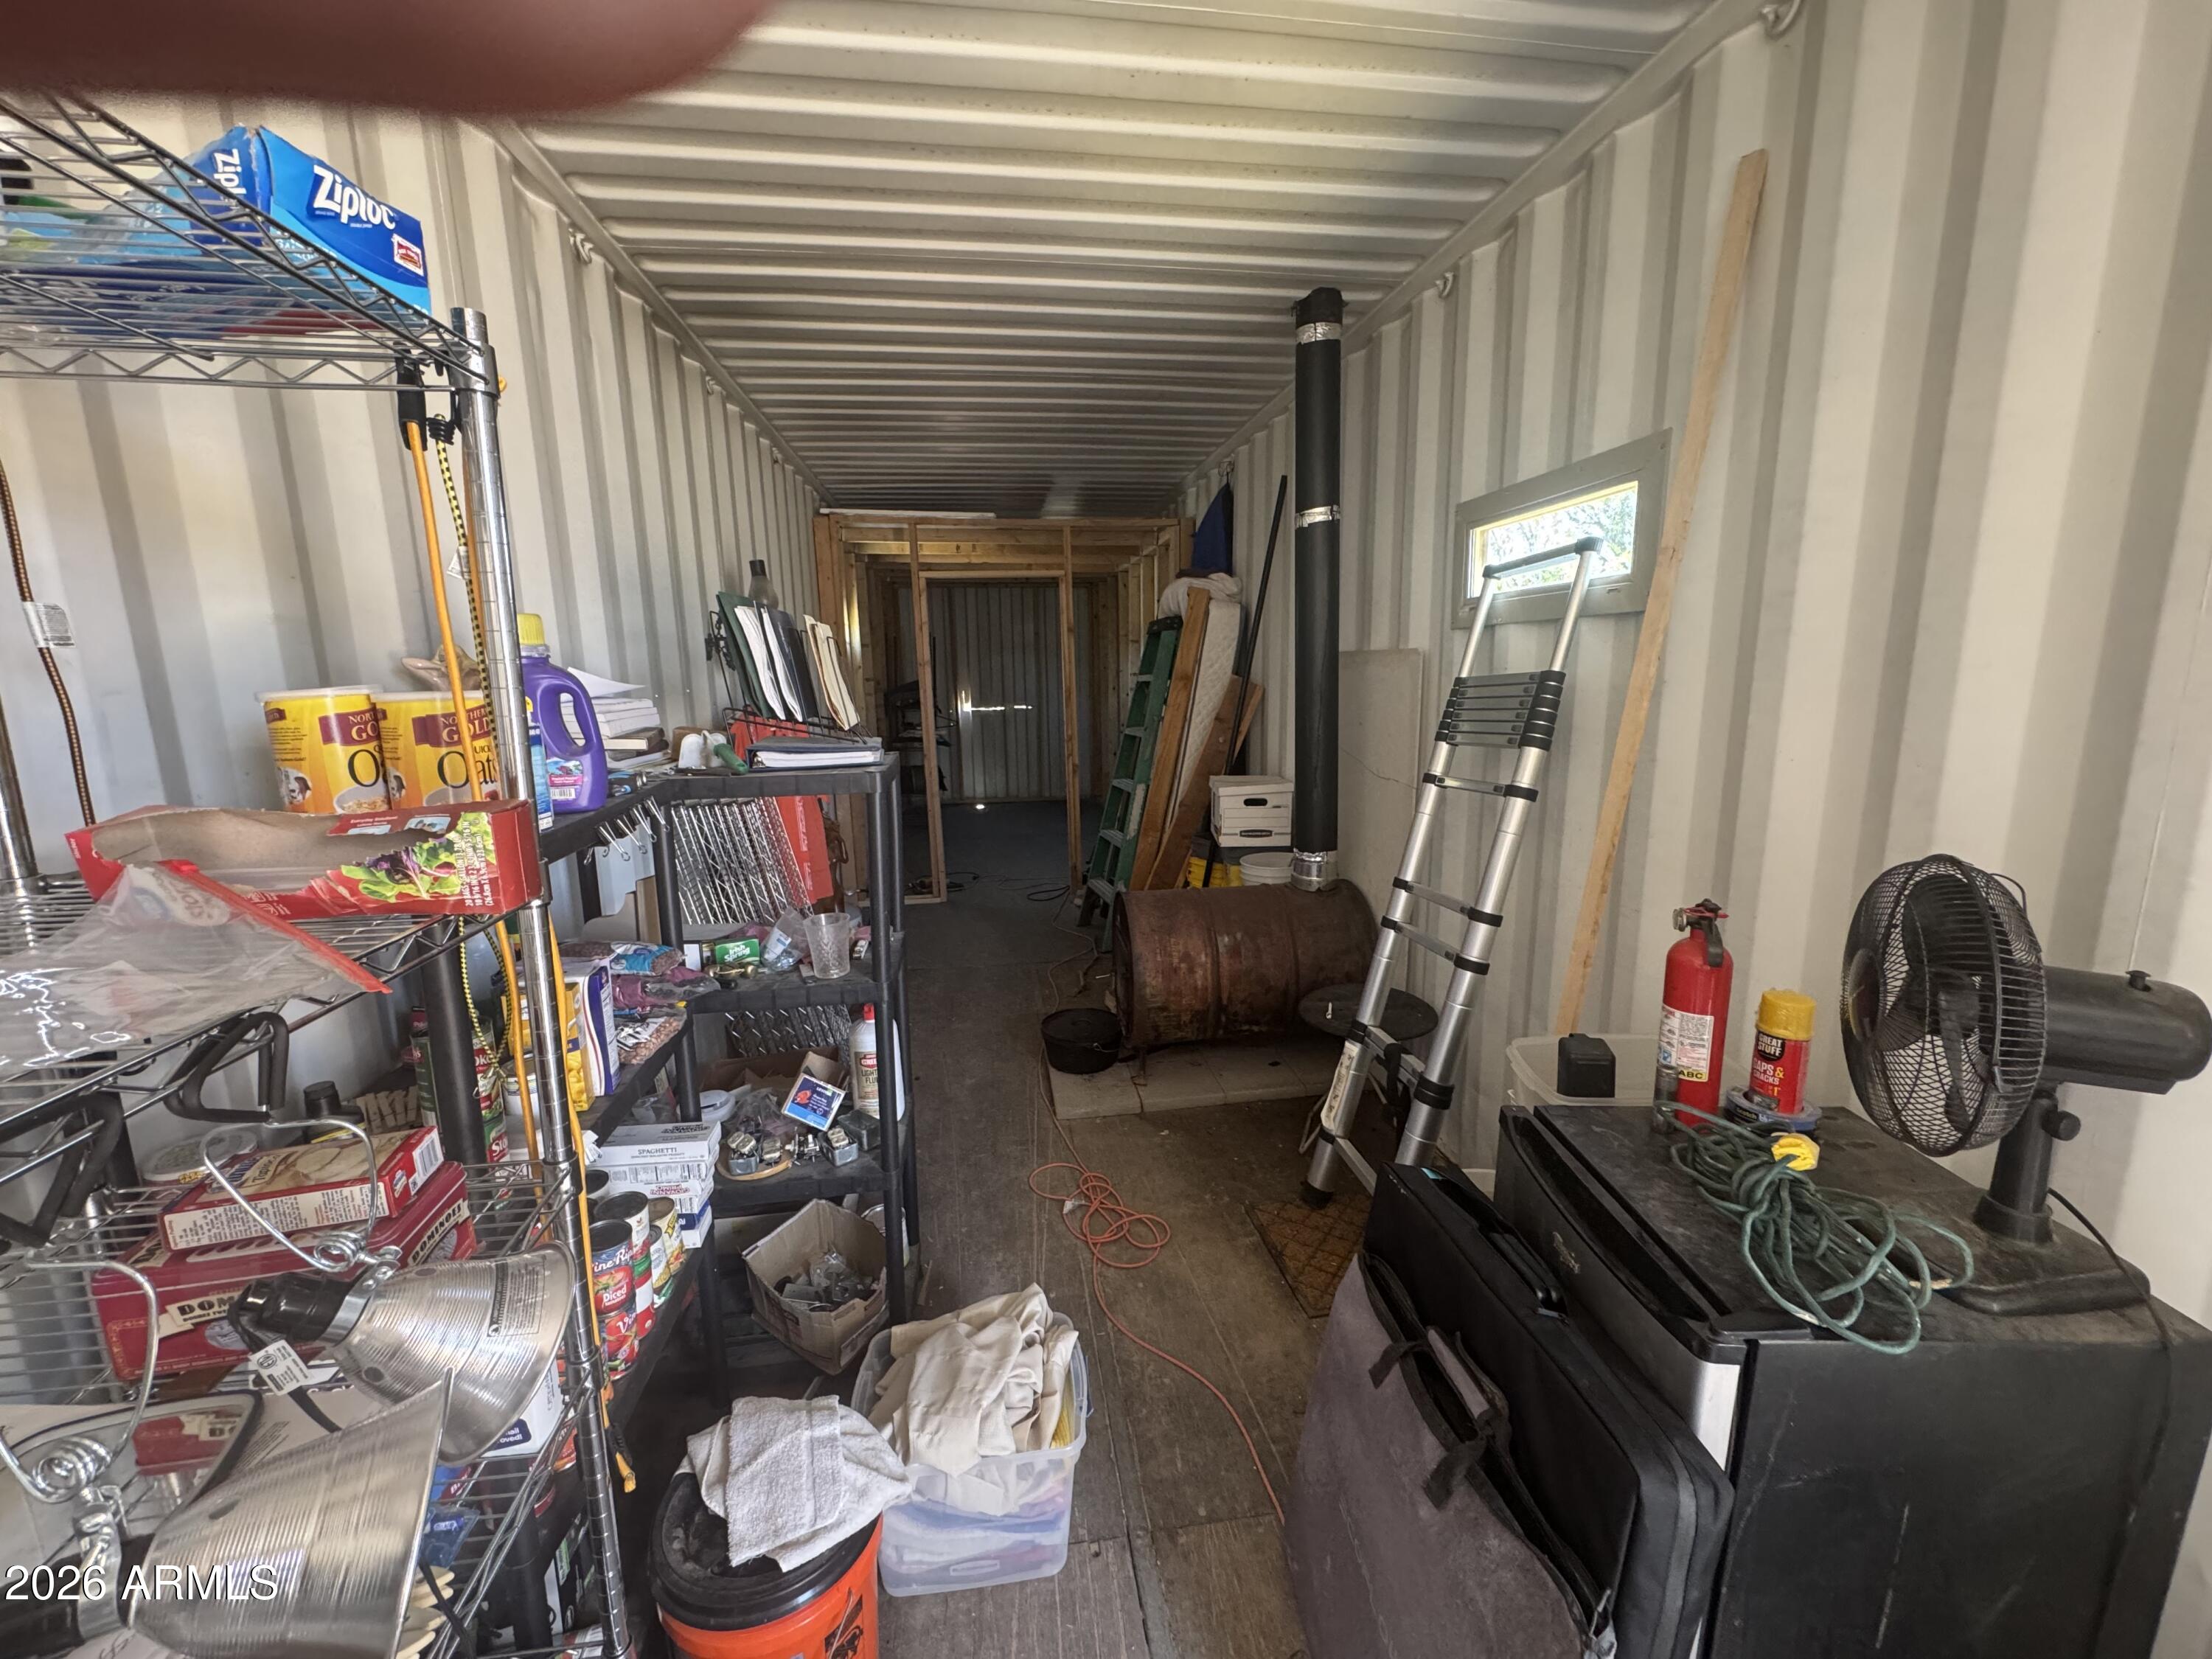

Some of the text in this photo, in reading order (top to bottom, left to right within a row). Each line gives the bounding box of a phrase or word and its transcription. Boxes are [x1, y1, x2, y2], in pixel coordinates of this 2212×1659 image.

[313, 165, 396, 230] Ziploc
[351, 720, 379, 741] GO
[724, 947, 751, 963] Spring
[728, 944, 745, 956] Irish
[1759, 1033, 1783, 1047] GREAT
[1758, 1043, 1782, 1057] STUFF
[1679, 1070, 1703, 1079] ABC
[1775, 1066, 1784, 1079] &
[638, 1147, 677, 1155] SPAGHETTI
[411, 1202, 462, 1264] DOMINOES
[602, 1284, 627, 1302] Diced
[500, 1433, 523, 1444] oved!
